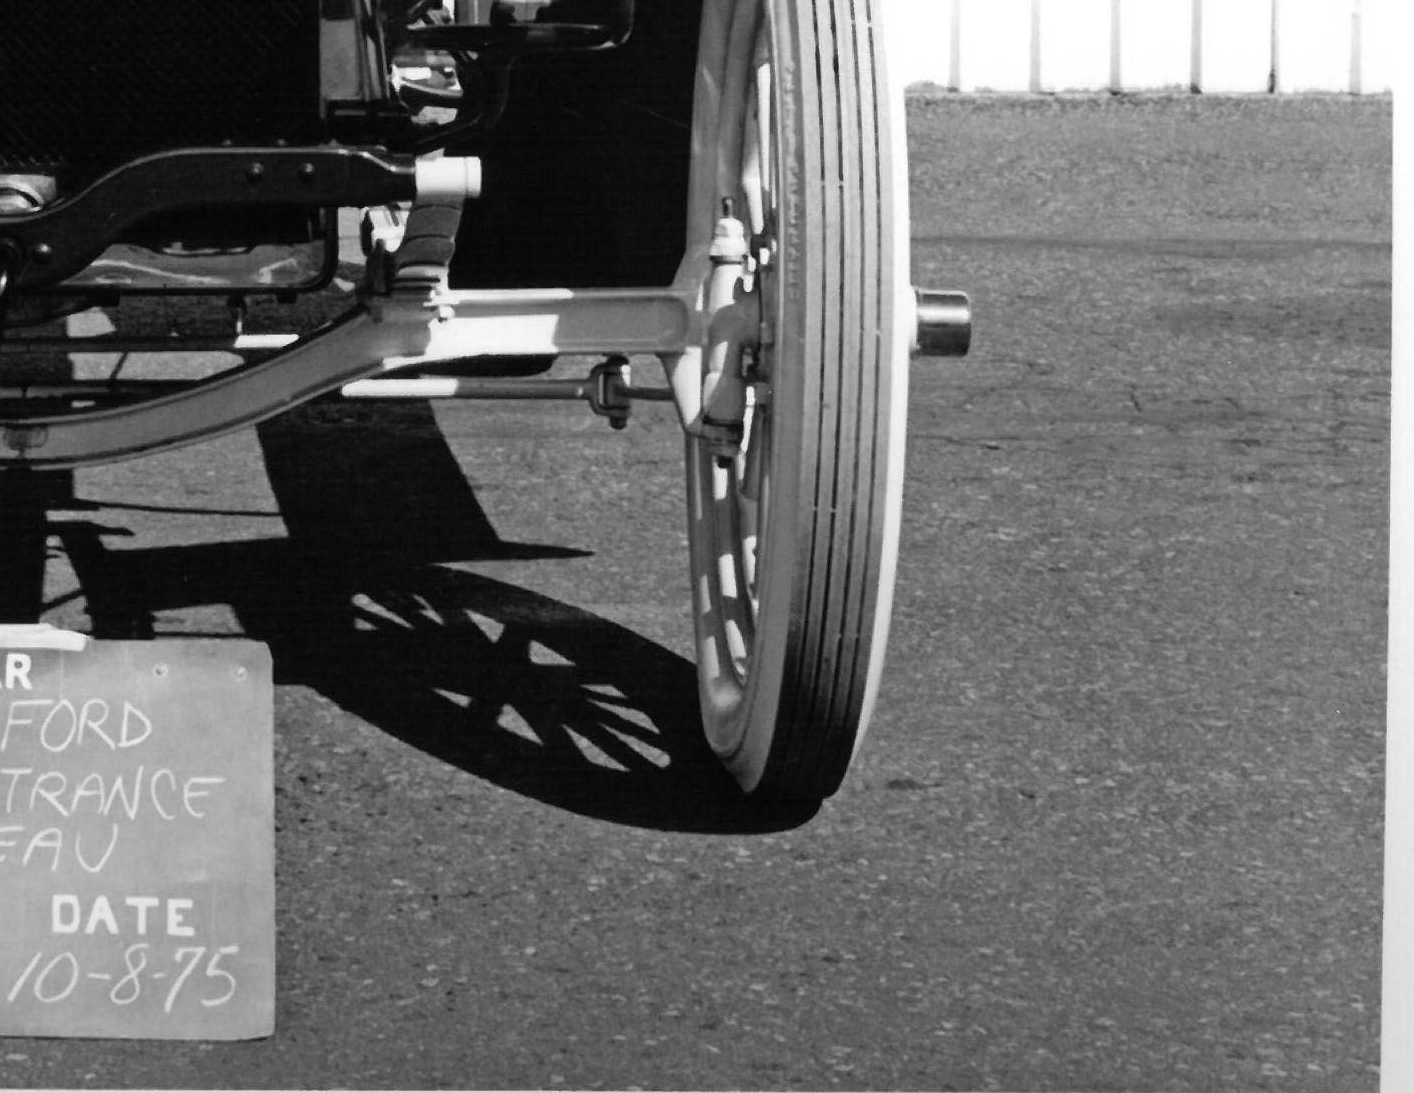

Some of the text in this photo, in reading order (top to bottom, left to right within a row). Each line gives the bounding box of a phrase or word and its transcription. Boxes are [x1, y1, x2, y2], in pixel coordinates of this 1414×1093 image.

[2, 698, 153, 752] FORD
[51, 894, 194, 936] DATE
[7, 943, 240, 1013] 10-8-75
